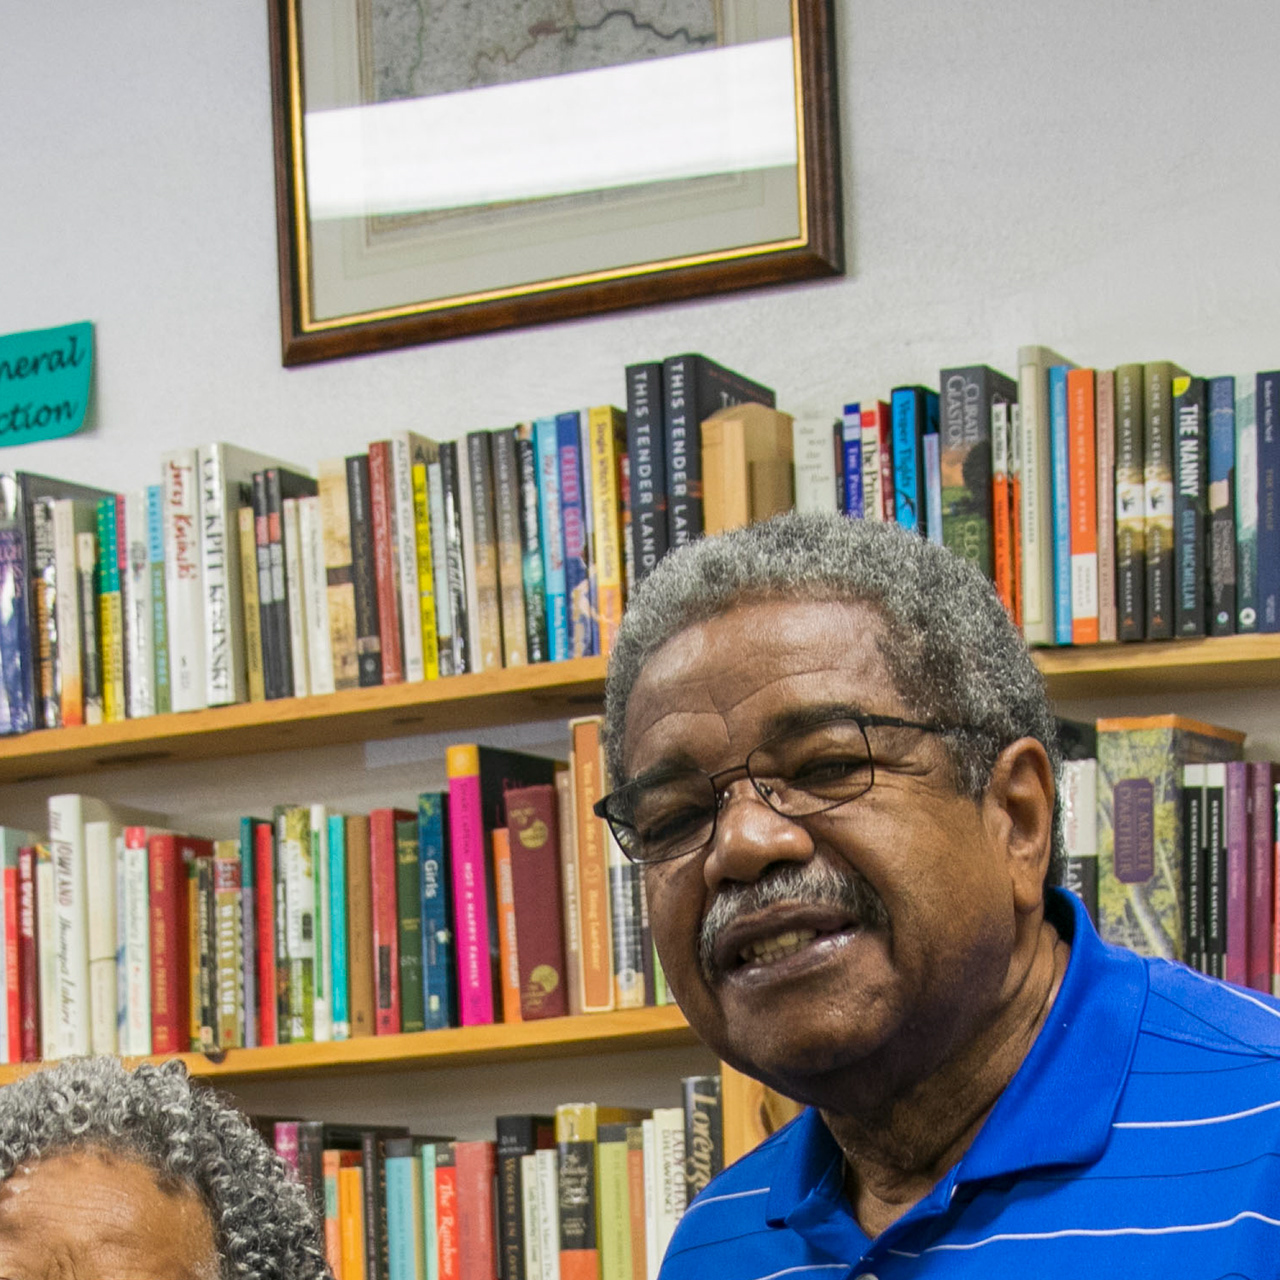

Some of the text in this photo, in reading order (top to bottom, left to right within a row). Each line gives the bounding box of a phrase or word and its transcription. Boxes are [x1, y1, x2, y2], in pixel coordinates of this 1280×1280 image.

[633, 371, 656, 568] THIS TENDER LAND
[670, 362, 687, 498] THIS TENDER
[900, 398, 915, 491] Vesper Flights
[1179, 404, 1198, 497] THE NANNY
[1182, 509, 1195, 610] GILLY MACMILLAN
[424, 859, 438, 898] Girls
[440, 1173, 456, 1277] The Rainbow
